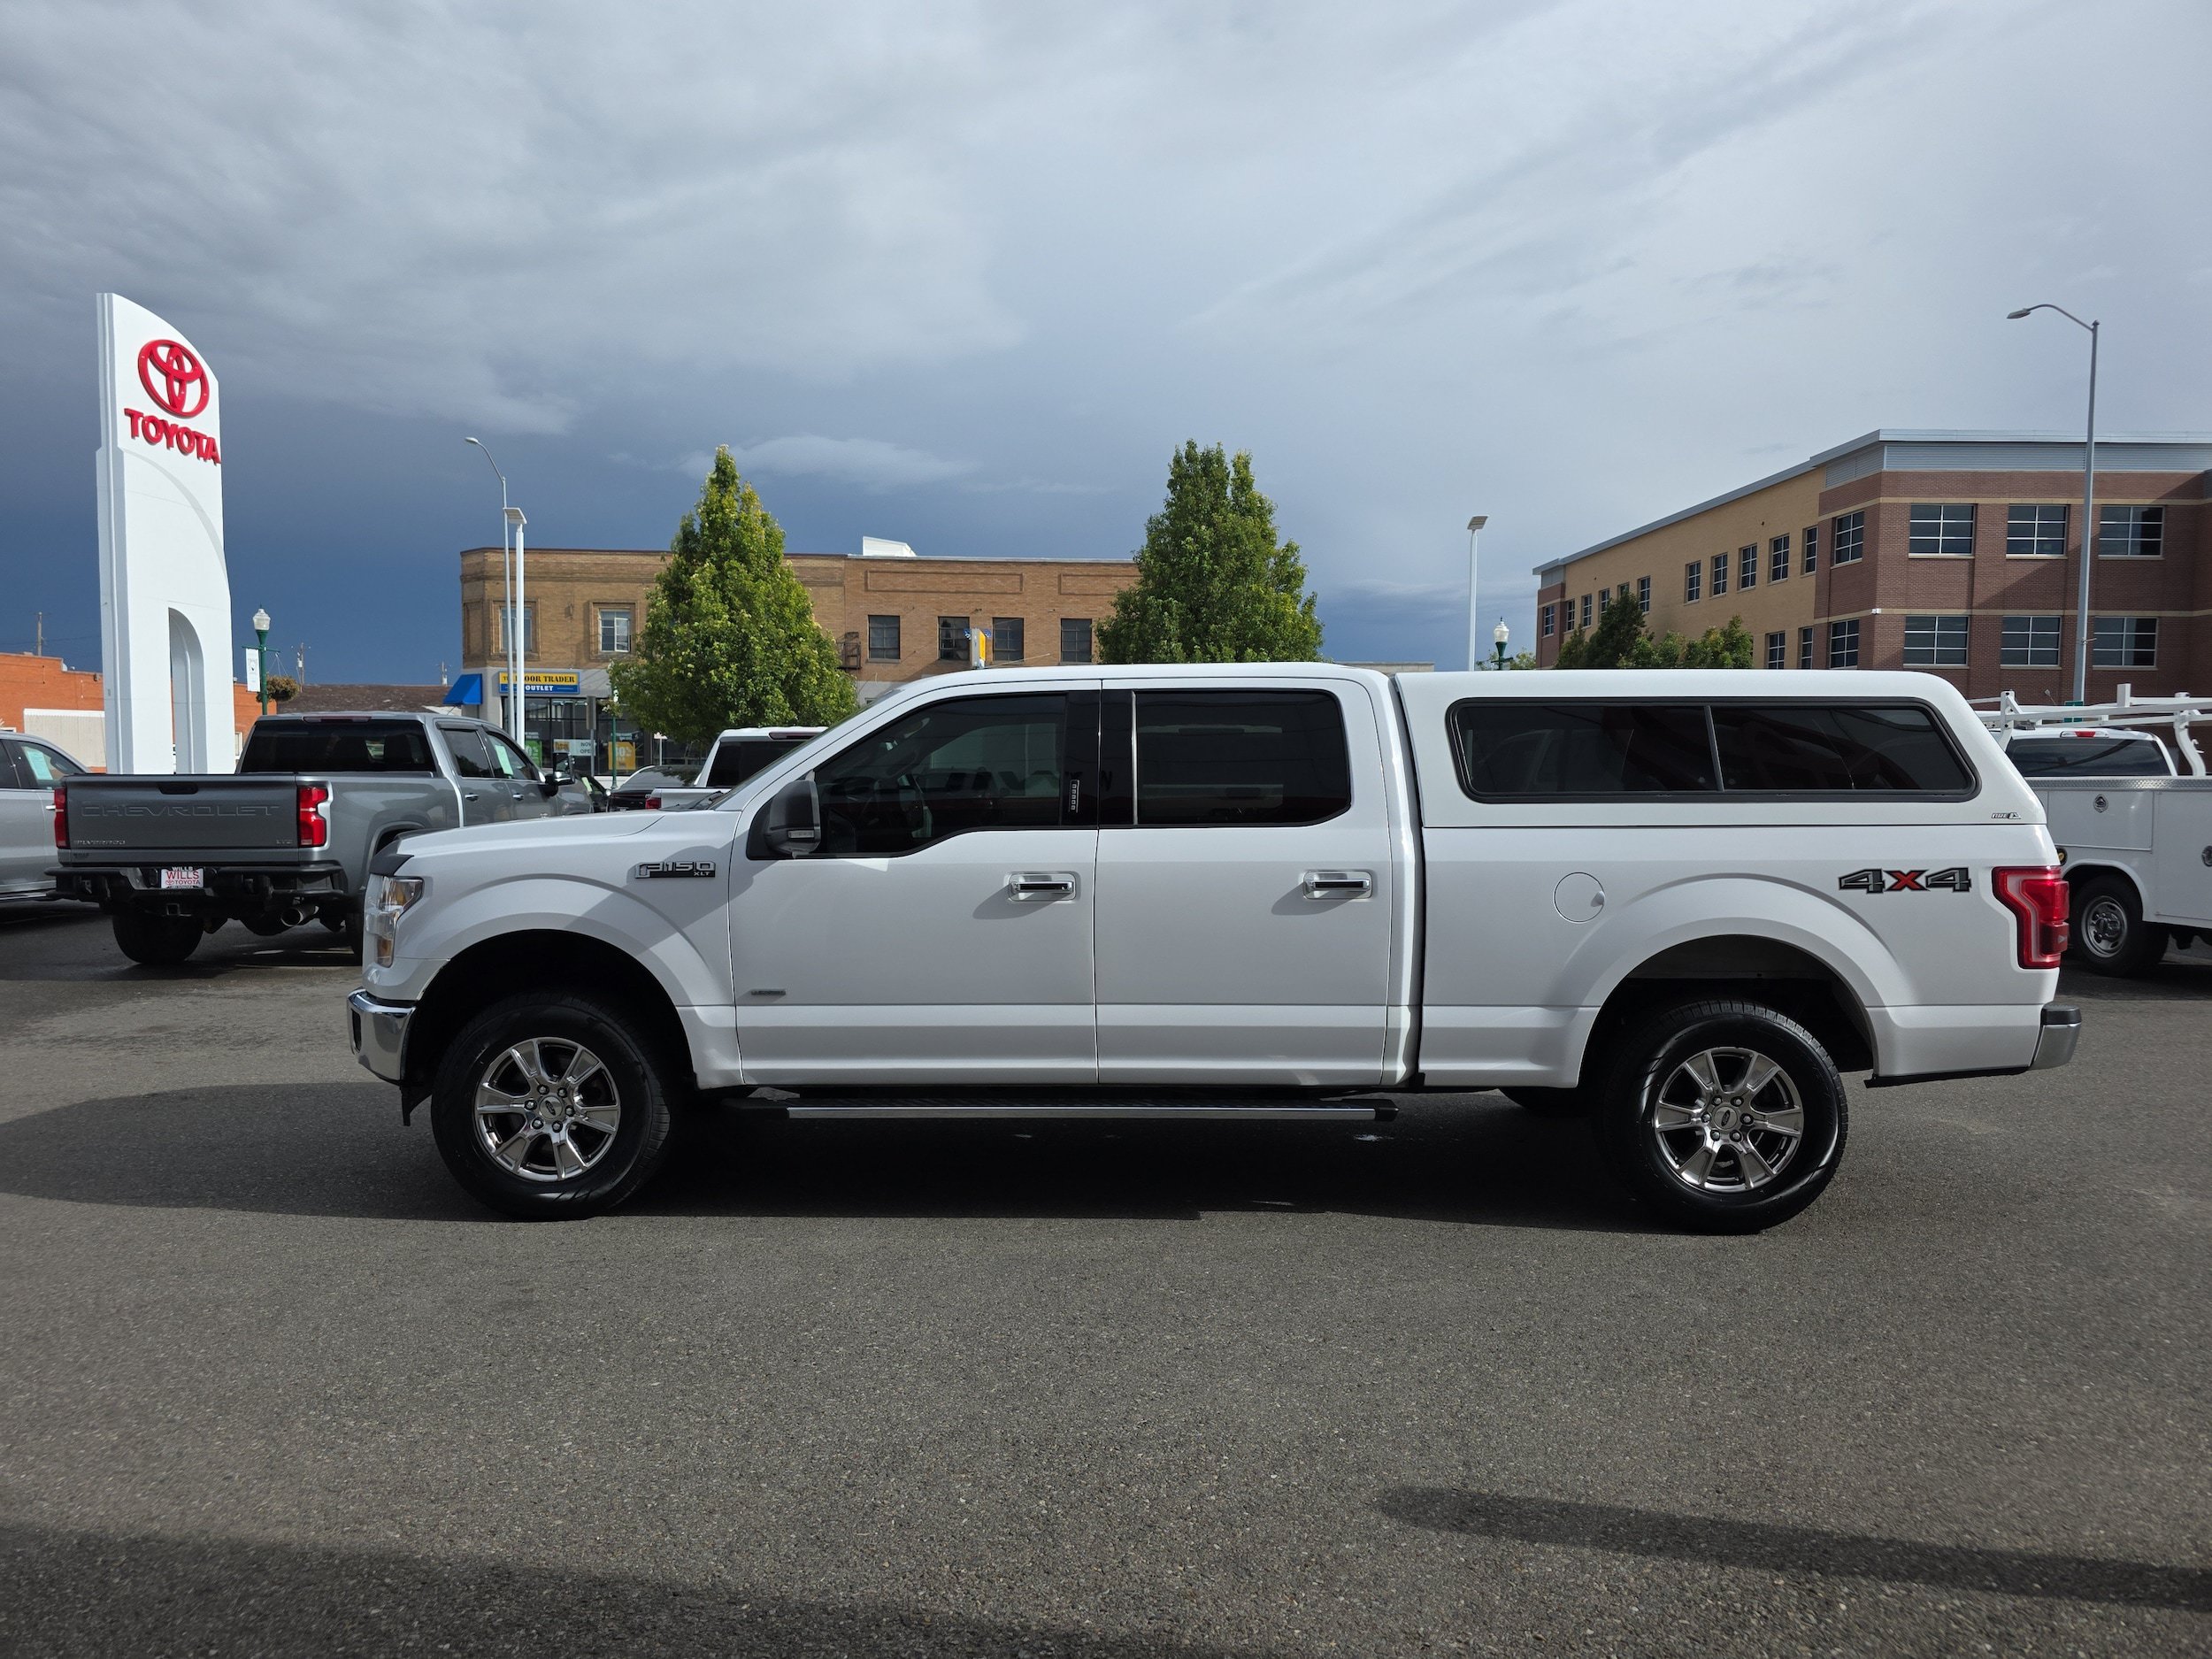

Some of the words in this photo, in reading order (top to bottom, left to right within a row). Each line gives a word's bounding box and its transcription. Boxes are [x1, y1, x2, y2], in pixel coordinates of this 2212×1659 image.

[124, 408, 221, 466] TOYOTA
[81, 806, 280, 817] CHEVROLET
[166, 871, 199, 879] WILLS
